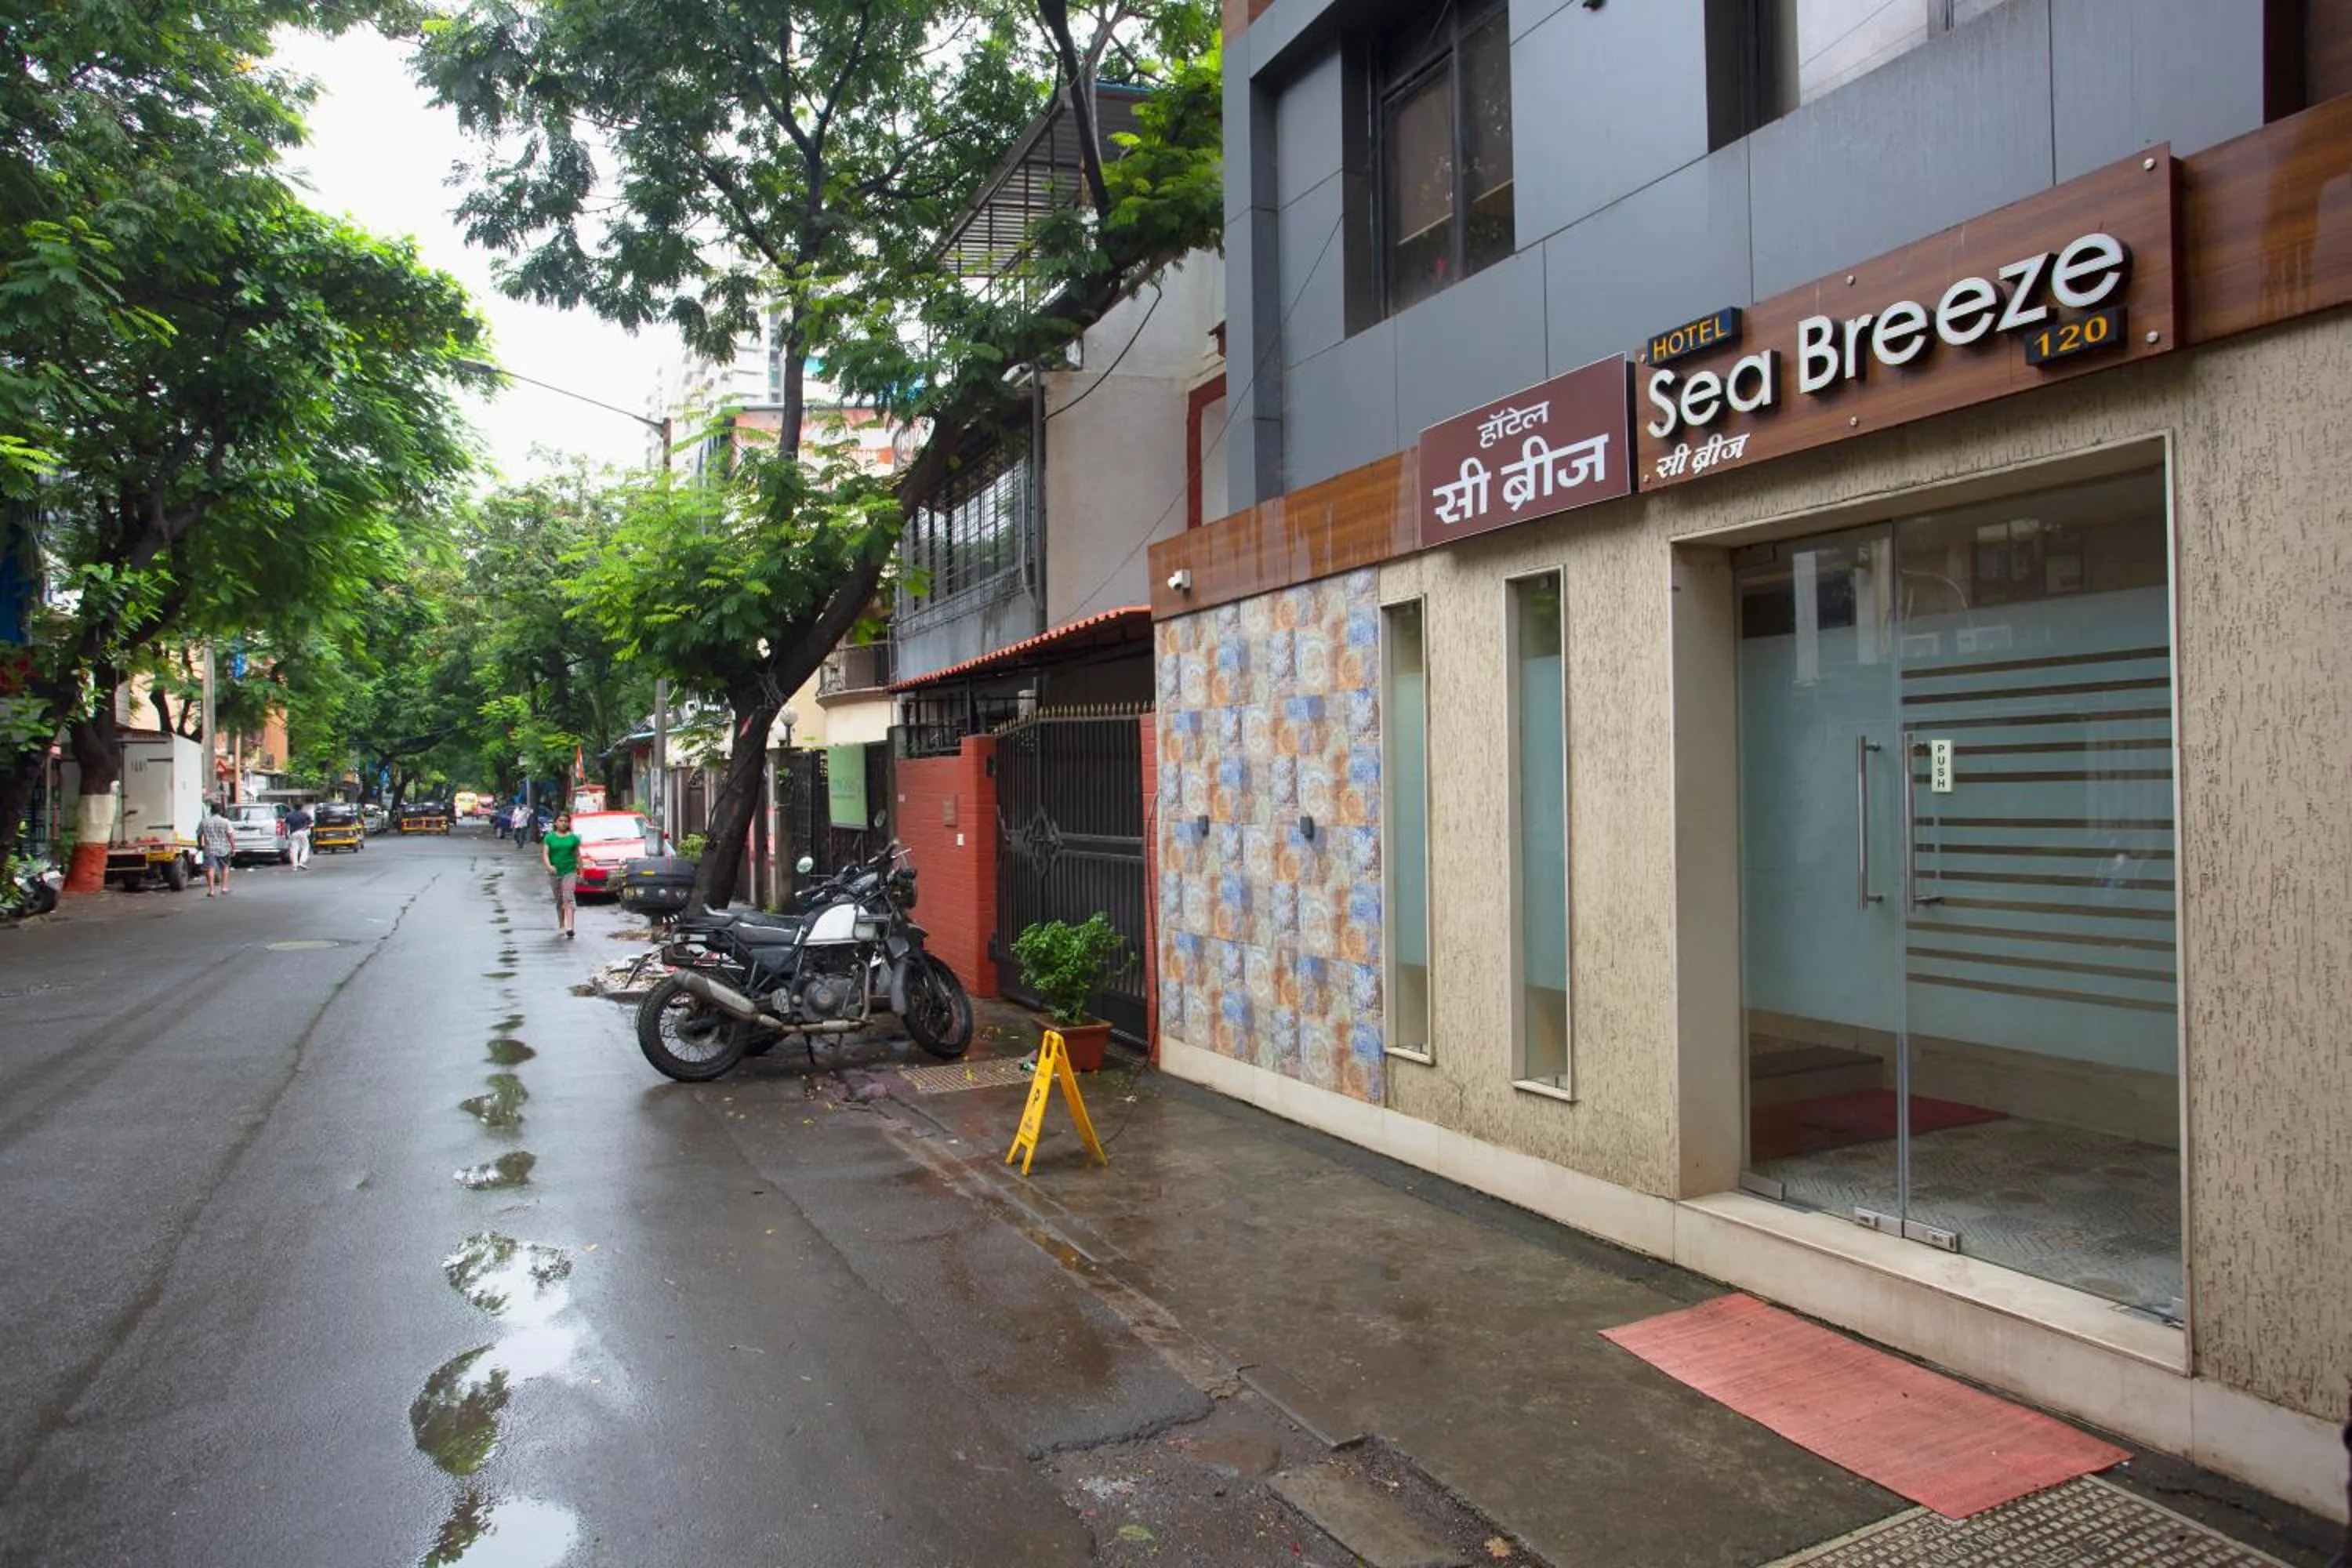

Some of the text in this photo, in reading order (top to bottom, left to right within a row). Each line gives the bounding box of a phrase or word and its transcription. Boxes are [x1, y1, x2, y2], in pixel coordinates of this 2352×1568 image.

[1647, 233, 2123, 438] Sea Breeze
[1653, 316, 1727, 361] HOTEL
[2034, 315, 2108, 357] 120
[1477, 401, 1550, 448] हॉटेल
[1432, 434, 1609, 524] सी ब्रीज
[1657, 442, 1691, 479] सी
